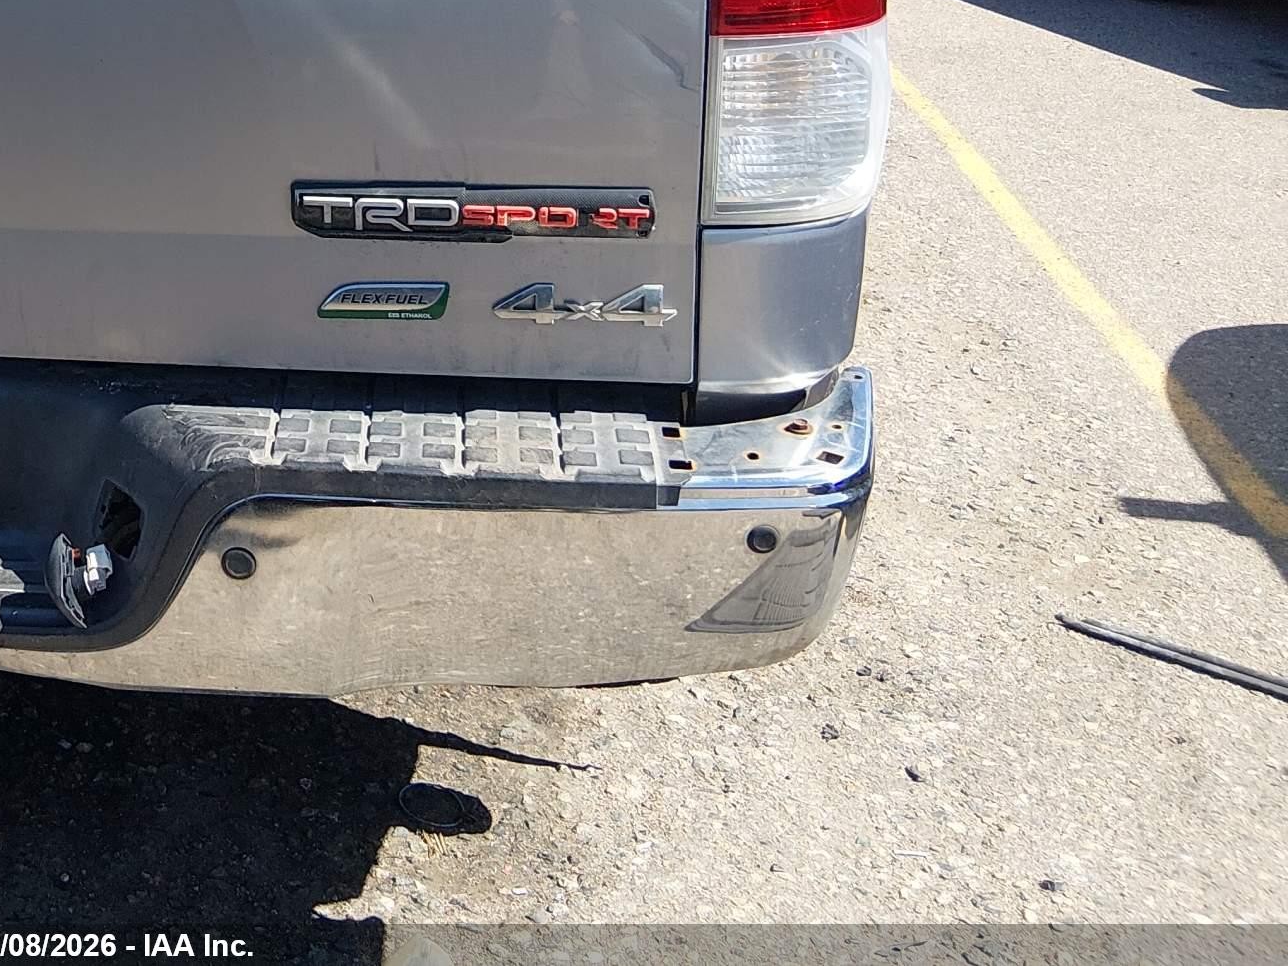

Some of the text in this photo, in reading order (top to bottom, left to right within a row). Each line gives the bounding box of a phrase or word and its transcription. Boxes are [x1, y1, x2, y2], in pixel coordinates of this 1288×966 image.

[302, 195, 461, 232] TRD
[340, 293, 429, 305] FLEX FUEL
